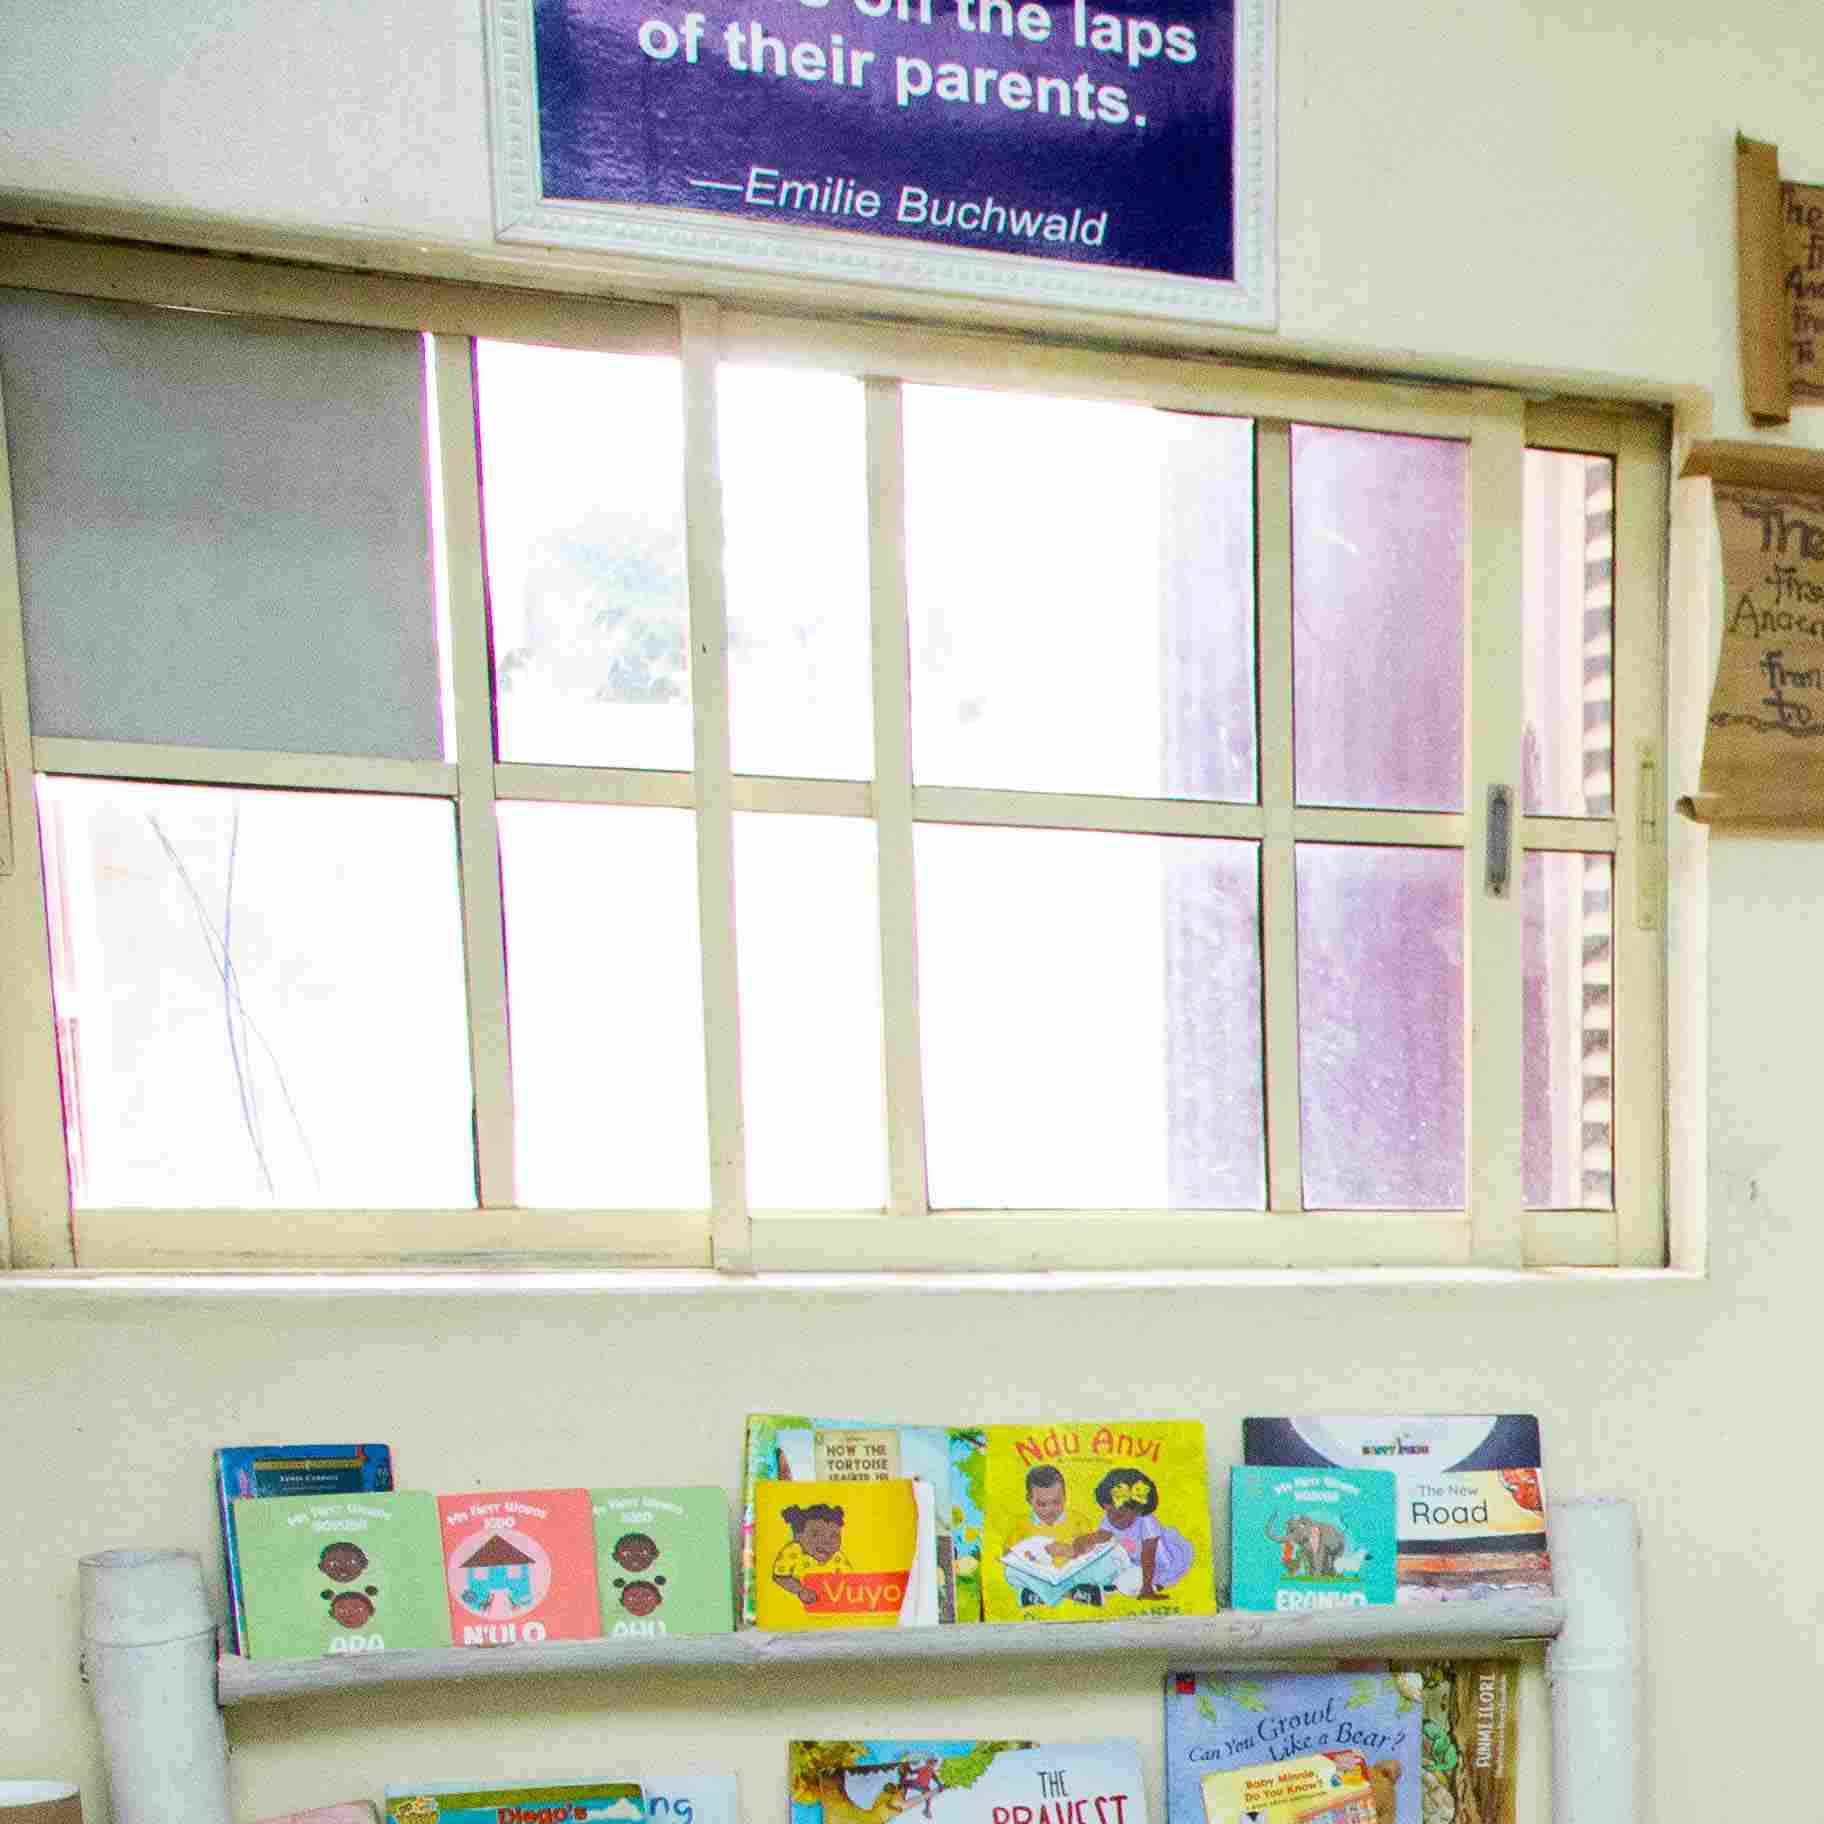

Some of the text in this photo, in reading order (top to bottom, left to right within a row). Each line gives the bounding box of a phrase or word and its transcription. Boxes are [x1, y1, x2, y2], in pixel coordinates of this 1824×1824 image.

[1073, 0, 1198, 68] laps
[637, 15, 1148, 127] of their parents.
[897, 189, 1108, 247] Buchwald
[826, 1458, 889, 1472] TORTOISE
[864, 1443, 888, 1457] THE
[1419, 1484, 1443, 1497] The
[1411, 1500, 1489, 1526] Road
[820, 1578, 900, 1612] Vuyo
[1257, 1697, 1340, 1741] Growl
[1187, 1743, 1222, 1763] Can
[1268, 1721, 1407, 1762] Like a Bear?
[1038, 1770, 1068, 1798] THE
